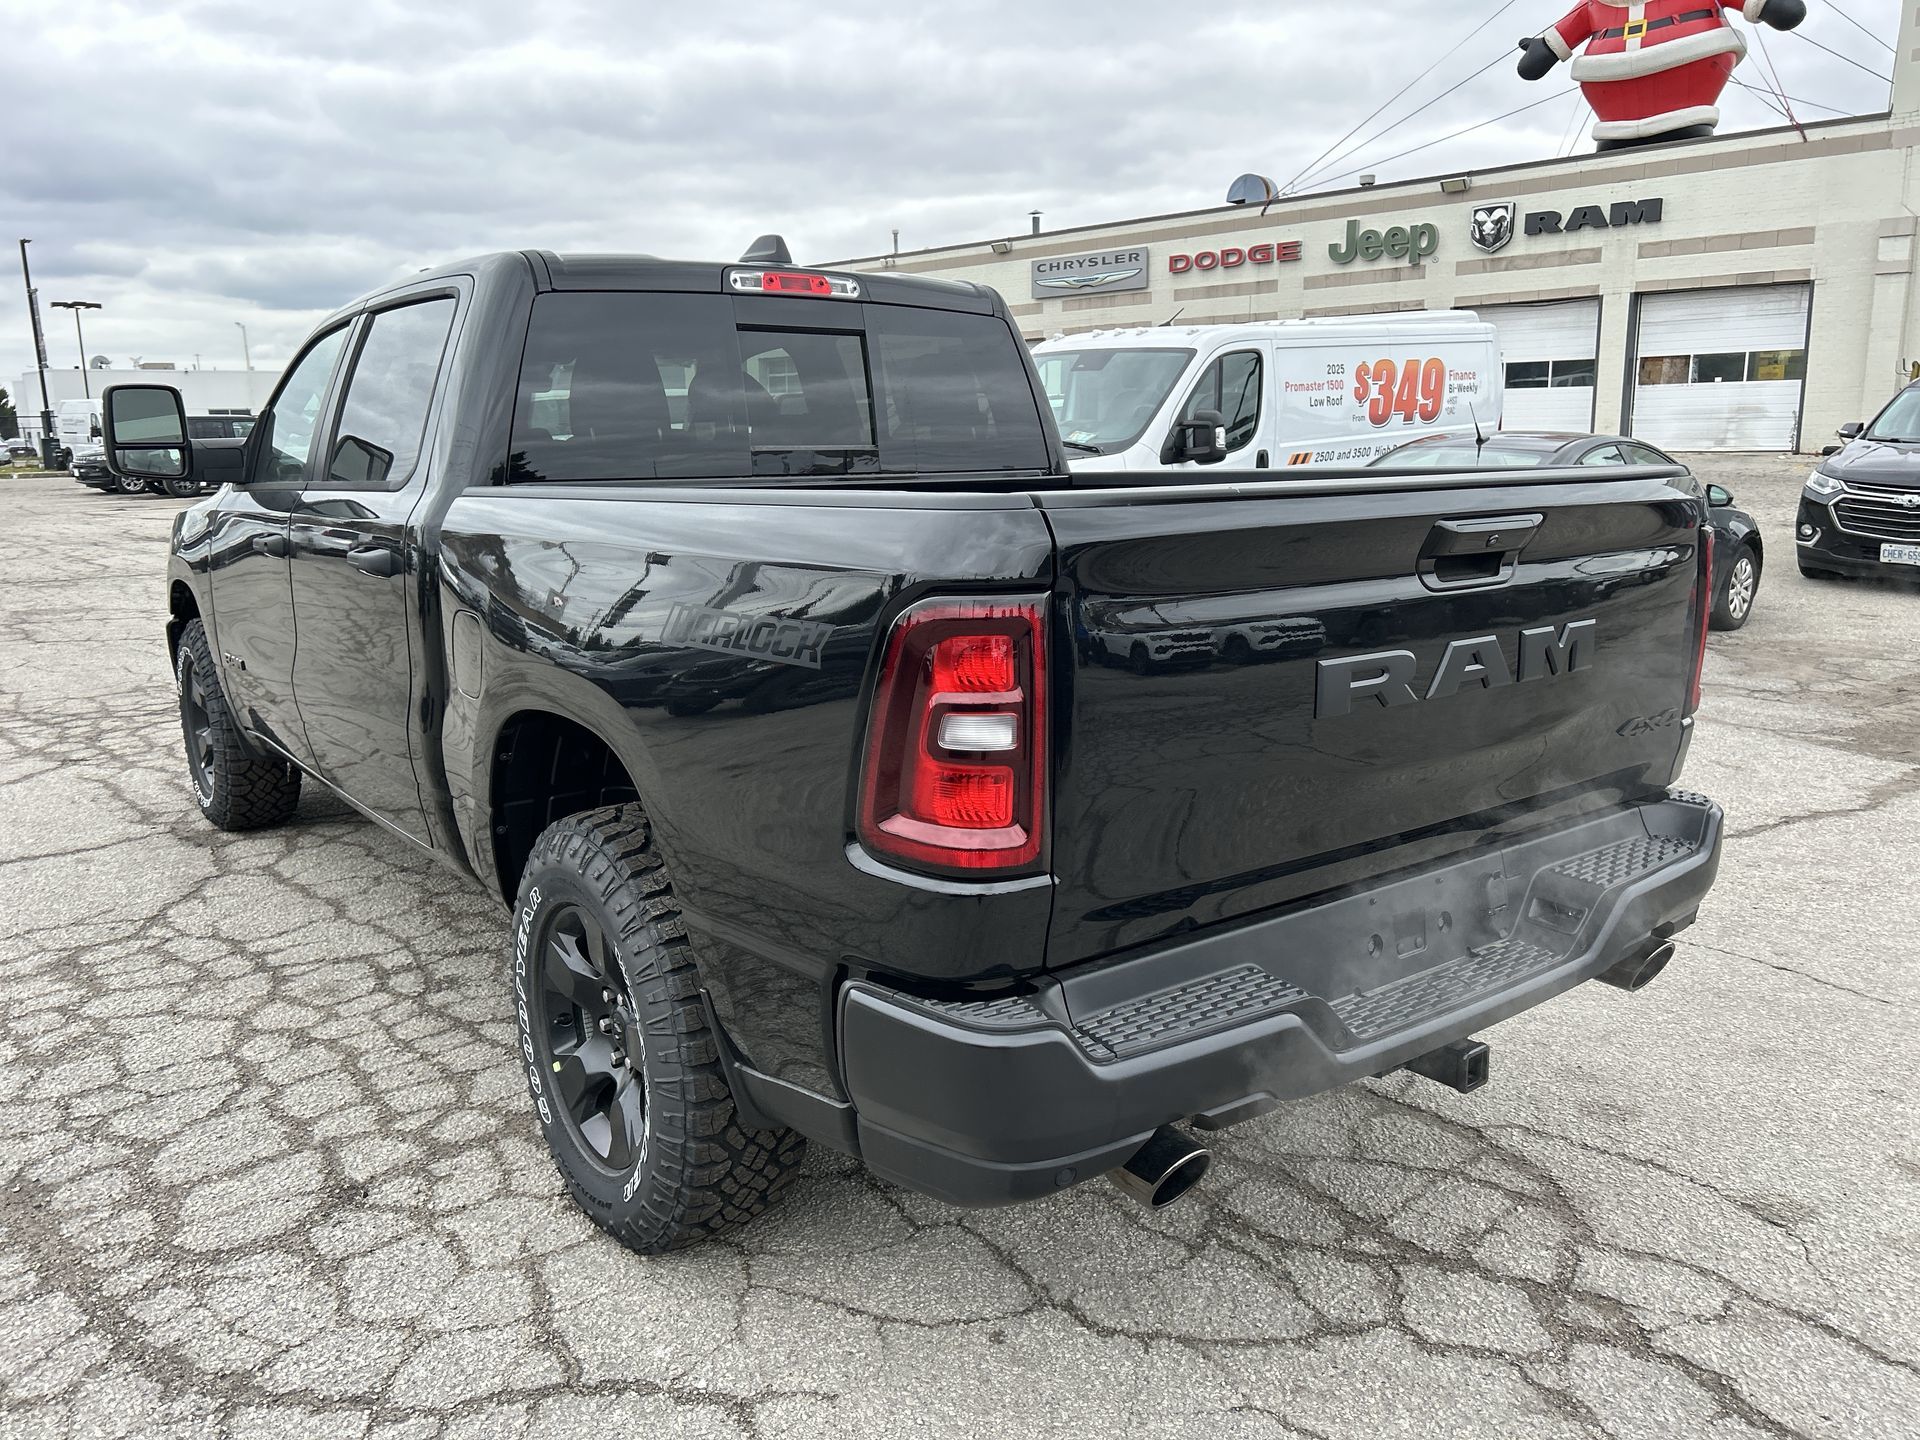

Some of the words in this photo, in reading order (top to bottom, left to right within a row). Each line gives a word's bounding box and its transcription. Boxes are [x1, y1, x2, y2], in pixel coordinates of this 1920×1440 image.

[1524, 197, 1663, 236] RAM
[1328, 219, 1439, 265] Jeep
[1036, 252, 1141, 273] CHRYSLER
[1168, 240, 1302, 274] DODGE
[1327, 364, 1345, 375] 2025
[1449, 369, 1476, 381] Finance
[1285, 380, 1325, 392] Promaster
[1327, 379, 1344, 391] 1500
[1353, 357, 1446, 428] $349
[1449, 382, 1478, 394] Bi-Weekly
[1309, 397, 1325, 407] Low
[1326, 395, 1343, 407] Roof
[1352, 414, 1366, 423] From
[1314, 451, 1335, 463] 2500
[1336, 450, 1351, 461] and
[1352, 447, 1372, 459] 3500
[1314, 618, 1597, 720] RAM
